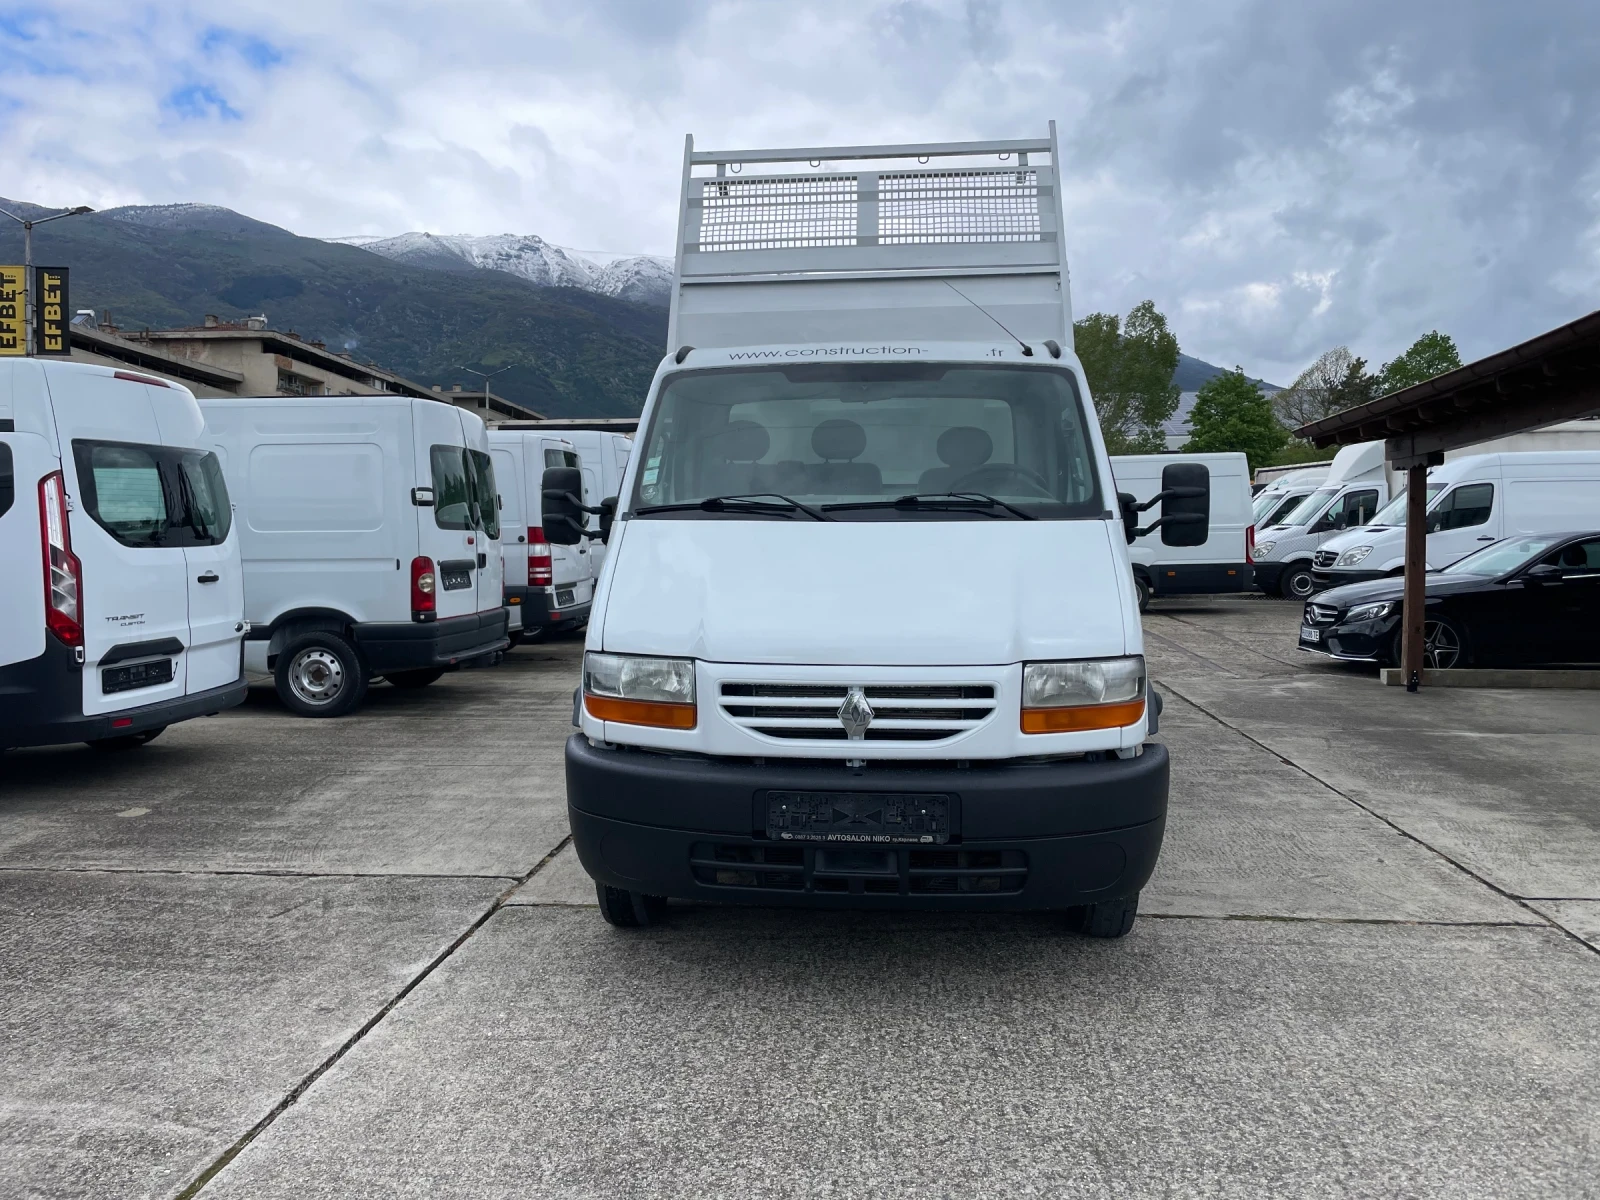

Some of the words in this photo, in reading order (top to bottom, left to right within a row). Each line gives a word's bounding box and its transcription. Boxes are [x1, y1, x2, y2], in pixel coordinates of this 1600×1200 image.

[0, 271, 17, 349] EFBET
[44, 272, 62, 350] EFBET
[105, 613, 145, 622] TRANSIT
[827, 833, 871, 842] AVTOSALON
[872, 835, 891, 843] NIKO
